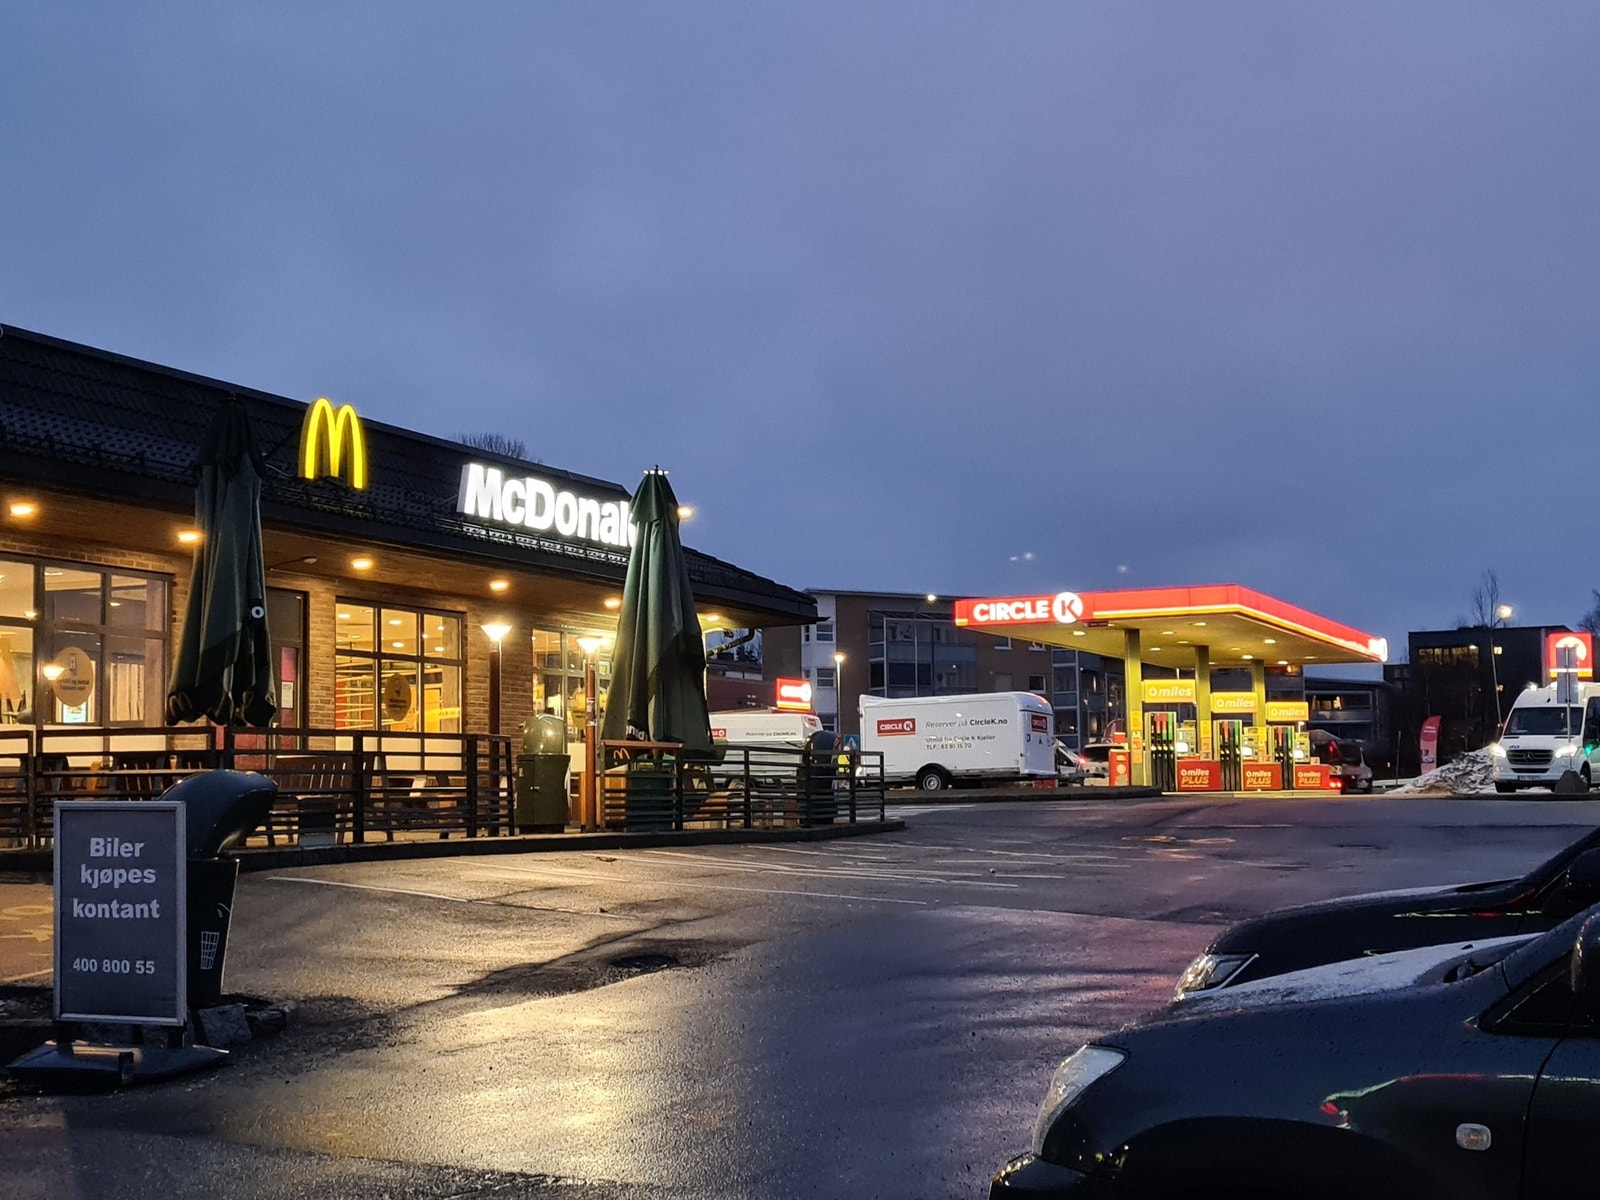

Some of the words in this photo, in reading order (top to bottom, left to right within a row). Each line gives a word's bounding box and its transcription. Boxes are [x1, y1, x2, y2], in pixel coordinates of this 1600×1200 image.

[973, 600, 1050, 622] CIRCLE
[1057, 595, 1083, 622] K
[1181, 776, 1210, 785] PLUS
[1246, 777, 1272, 785] PLUS
[1298, 777, 1321, 785] PLUS
[89, 837, 145, 858] Biler
[80, 864, 157, 889] kjøpes
[72, 898, 160, 919] kontant
[72, 958, 98, 972] 400
[102, 959, 131, 974] 800
[135, 960, 156, 975] 55
